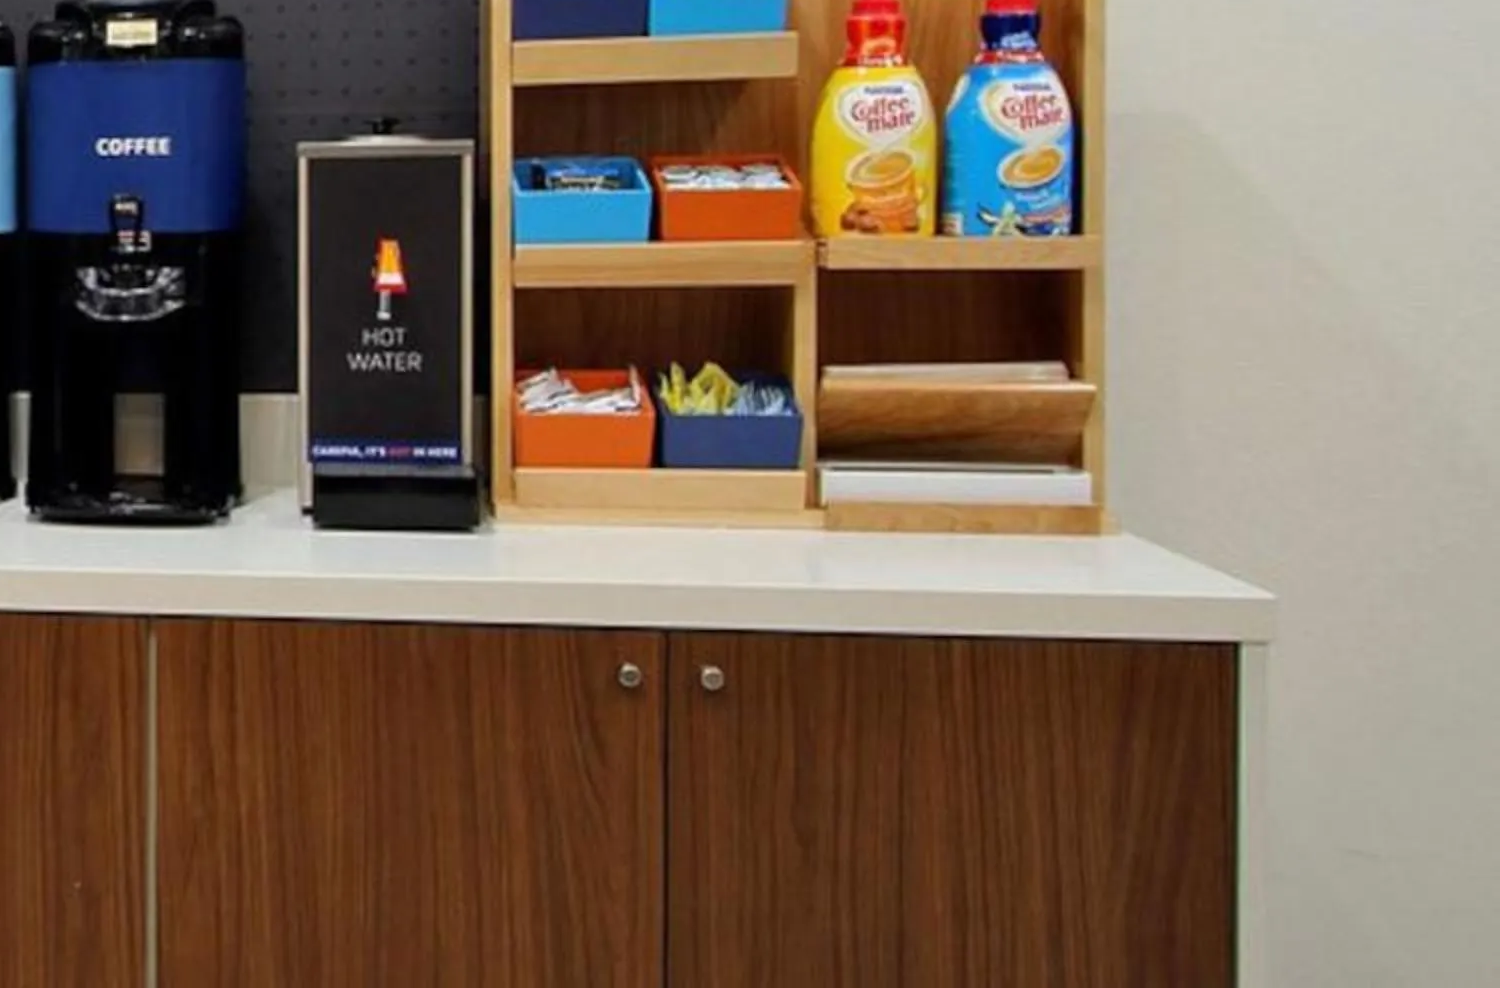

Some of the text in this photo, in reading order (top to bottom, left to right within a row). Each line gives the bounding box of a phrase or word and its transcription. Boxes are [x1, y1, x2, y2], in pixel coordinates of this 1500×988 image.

[95, 137, 172, 156] COFFEE
[362, 328, 407, 346] HOT
[347, 352, 422, 372] WATER
